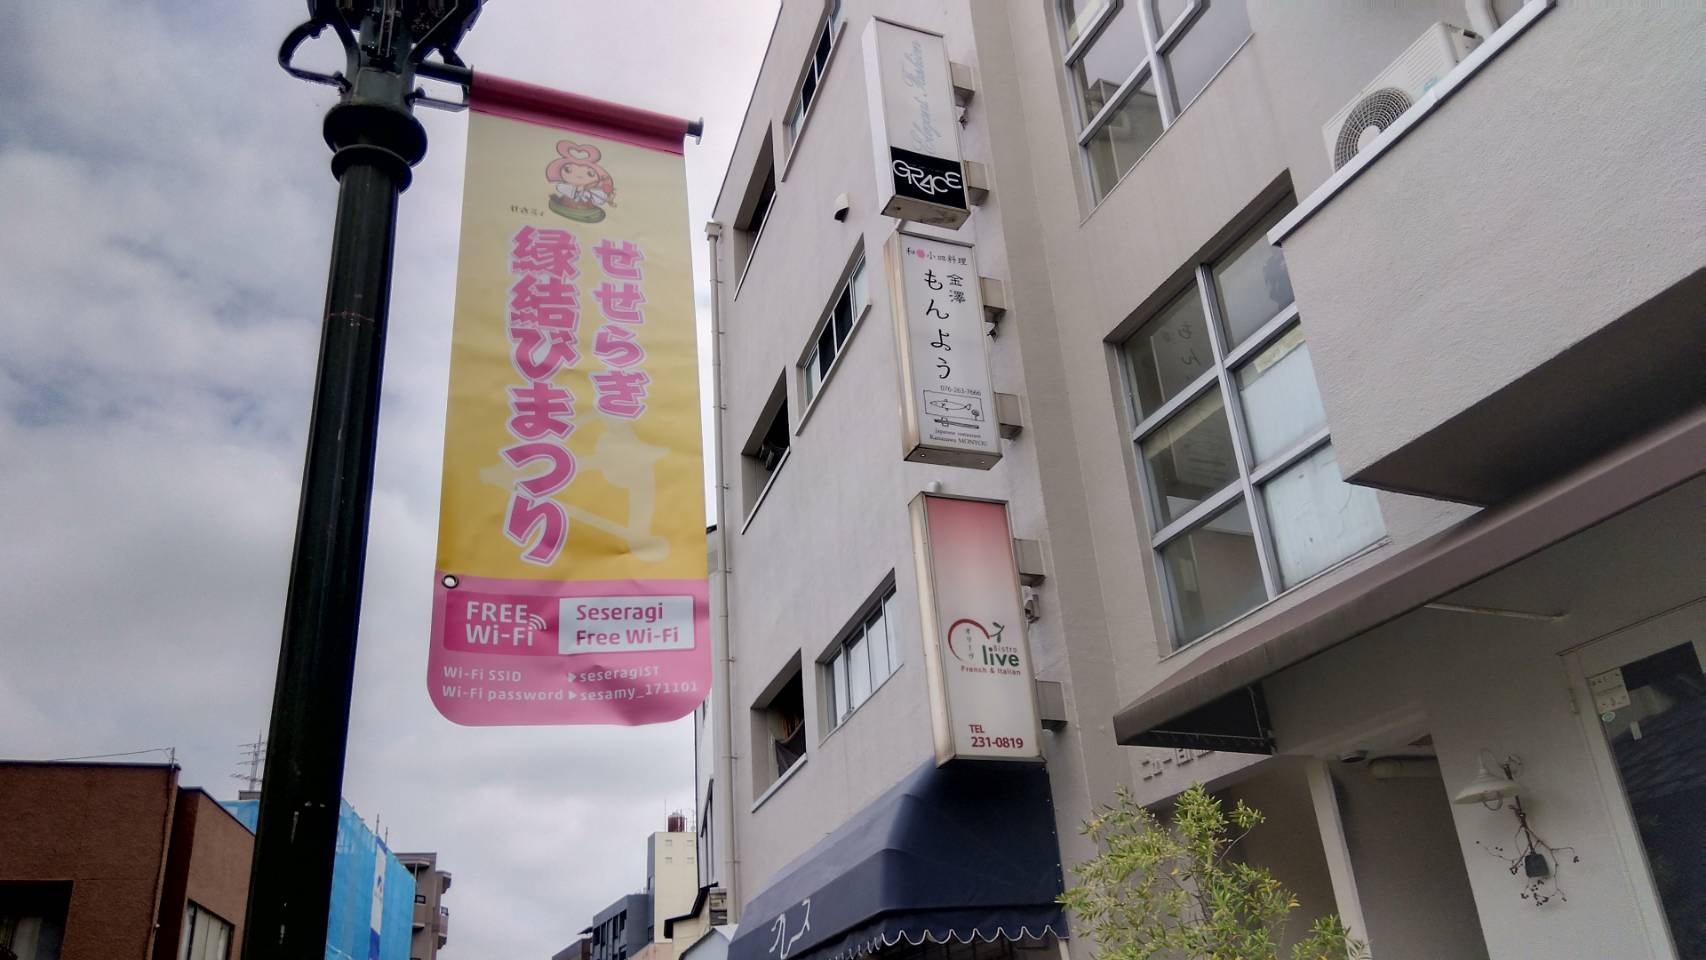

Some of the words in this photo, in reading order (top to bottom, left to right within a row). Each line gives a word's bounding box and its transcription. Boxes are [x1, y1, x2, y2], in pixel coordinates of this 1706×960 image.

[892, 159, 963, 195] GRACE
[946, 273, 966, 304] 金澤
[591, 238, 650, 417] せせらぎ
[924, 269, 952, 379] もんよう
[501, 226, 581, 565] 縁結びまつり
[467, 600, 528, 624] FREE
[576, 602, 663, 623] Seseragi
[466, 624, 533, 646] Wi-Fi
[576, 629, 620, 645] Free
[626, 626, 679, 645] Wi-Fi
[443, 665, 484, 680] Wi-Fi
[488, 670, 521, 682] SSID
[580, 665, 659, 682] seseragiST
[961, 665, 988, 674] French
[997, 667, 1021, 676] Italian
[442, 685, 483, 699] Wi-Fi
[488, 688, 563, 702] password
[580, 681, 697, 700] sesamy_171101
[968, 724, 985, 734] TEL
[971, 736, 1024, 749] 231-0819
